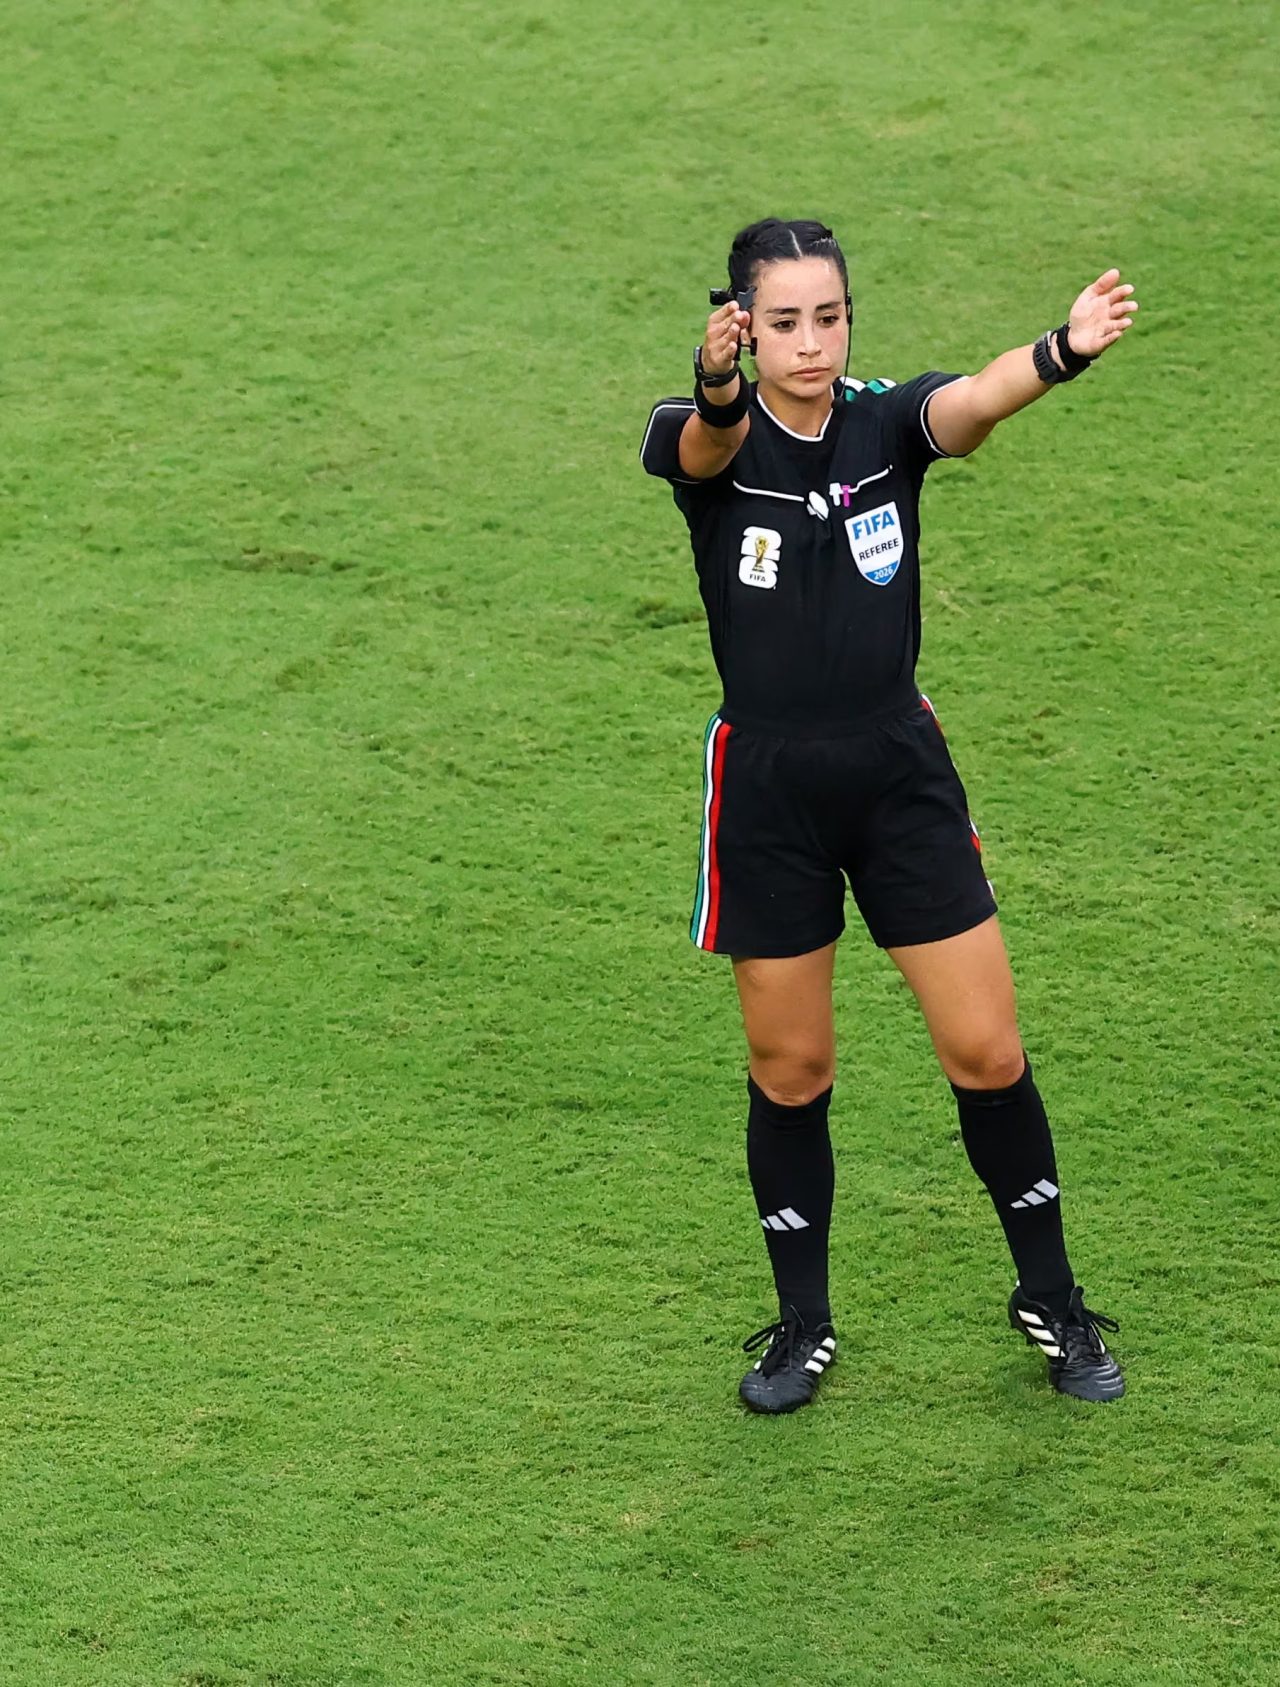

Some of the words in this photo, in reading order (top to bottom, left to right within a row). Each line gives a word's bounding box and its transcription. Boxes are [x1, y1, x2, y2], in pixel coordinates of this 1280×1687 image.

[852, 510, 895, 540] FIFA
[858, 537, 900, 561] REFEREE
[749, 574, 766, 582] FIFA
[873, 565, 894, 580] 2026
